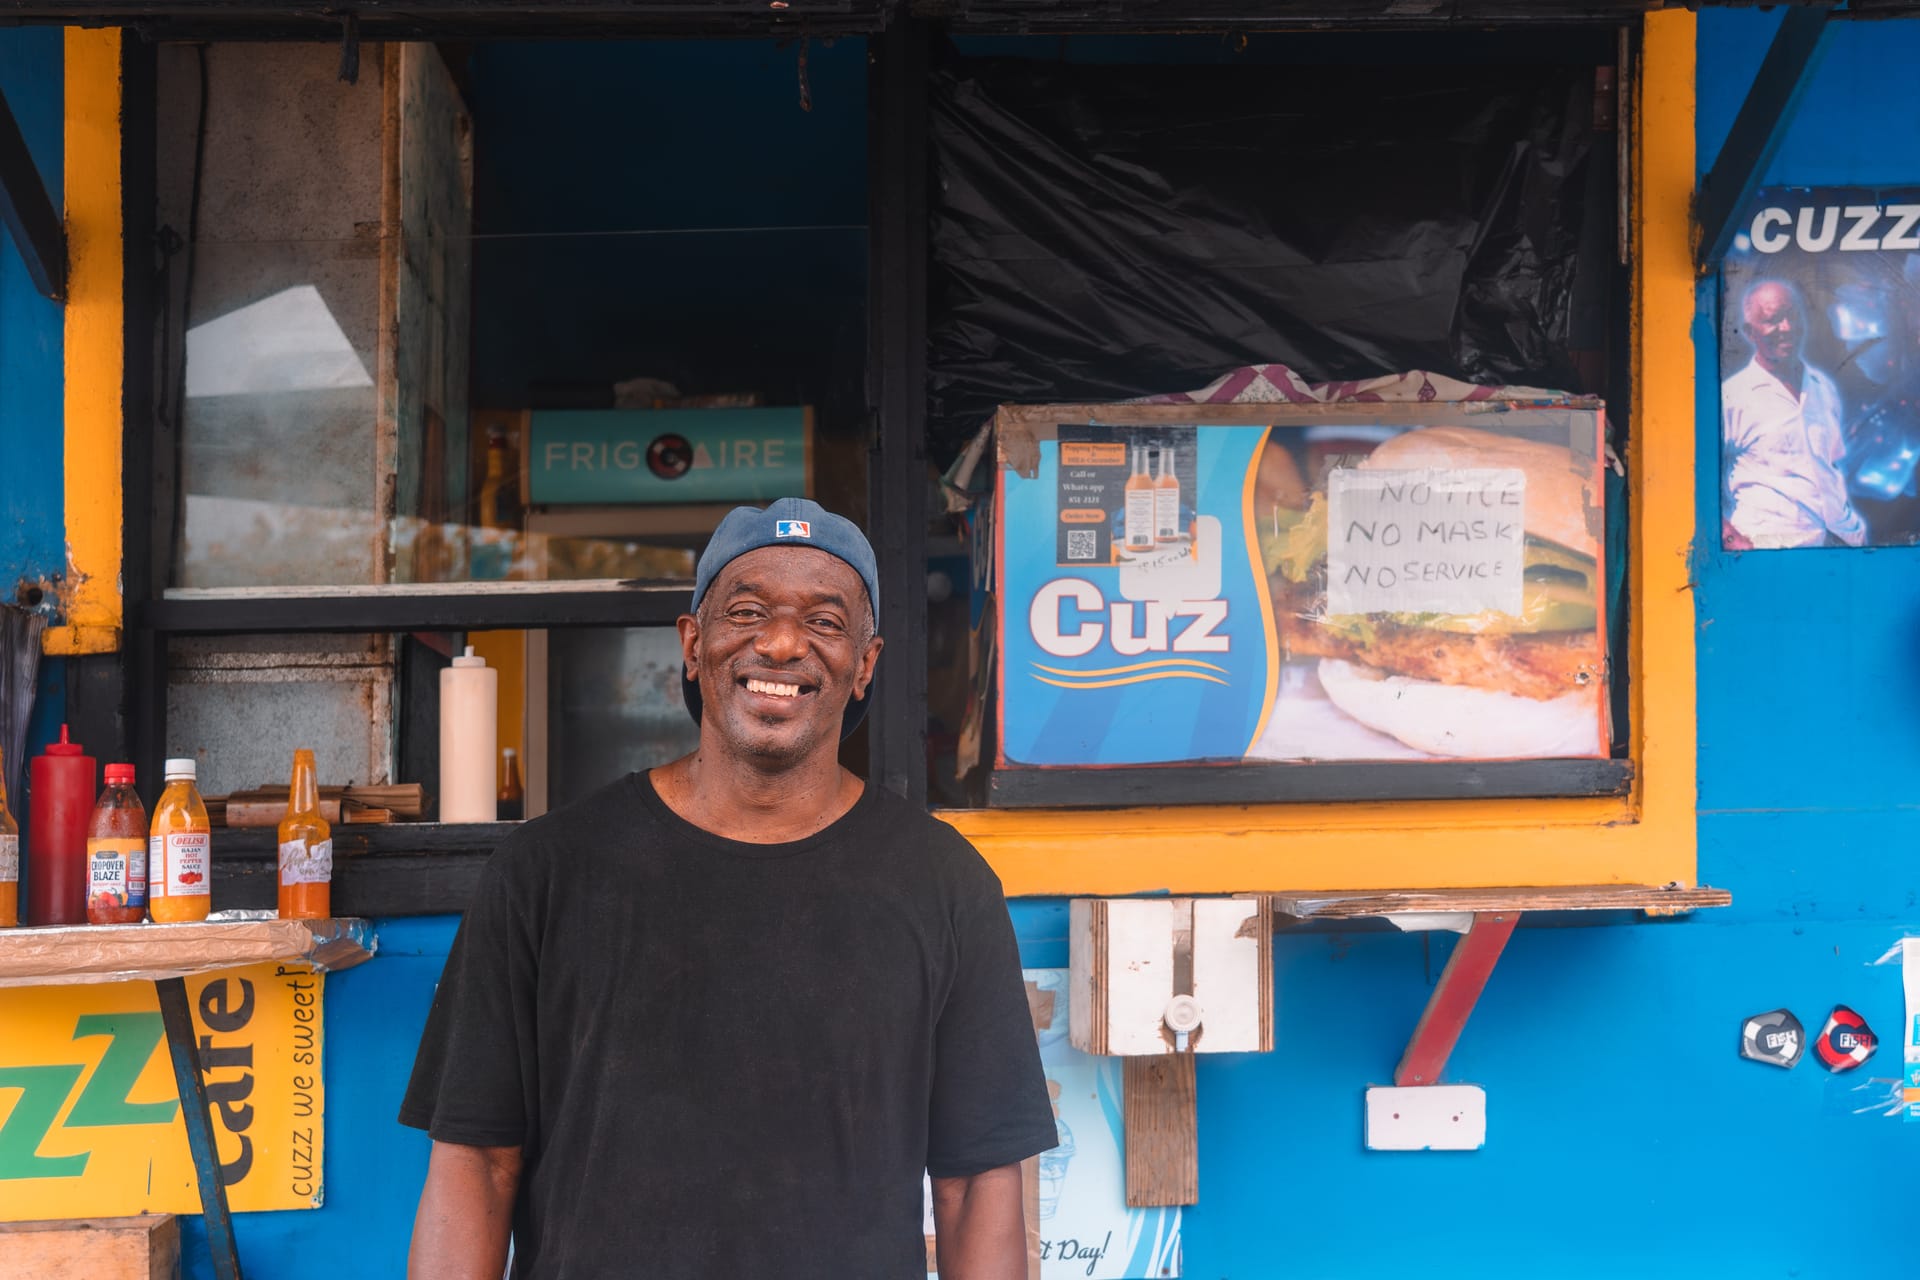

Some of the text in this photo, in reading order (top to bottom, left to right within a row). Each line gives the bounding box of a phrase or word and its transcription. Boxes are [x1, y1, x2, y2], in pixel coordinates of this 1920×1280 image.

[1750, 204, 1920, 253] CUZZ
[1070, 470, 1087, 478] Call
[1379, 481, 1521, 508] NOTICE
[1346, 519, 1514, 547] NO MASK
[1343, 560, 1504, 589] NO SERVICE
[1029, 577, 1230, 657] Cuz
[93, 870, 121, 881] BLAZE
[1766, 1030, 1797, 1048] FISH
[1840, 1033, 1872, 1048] FISH
[293, 1075, 314, 1118] we
[292, 1127, 314, 1197] cuzz
[1057, 1230, 1113, 1276] Day!
